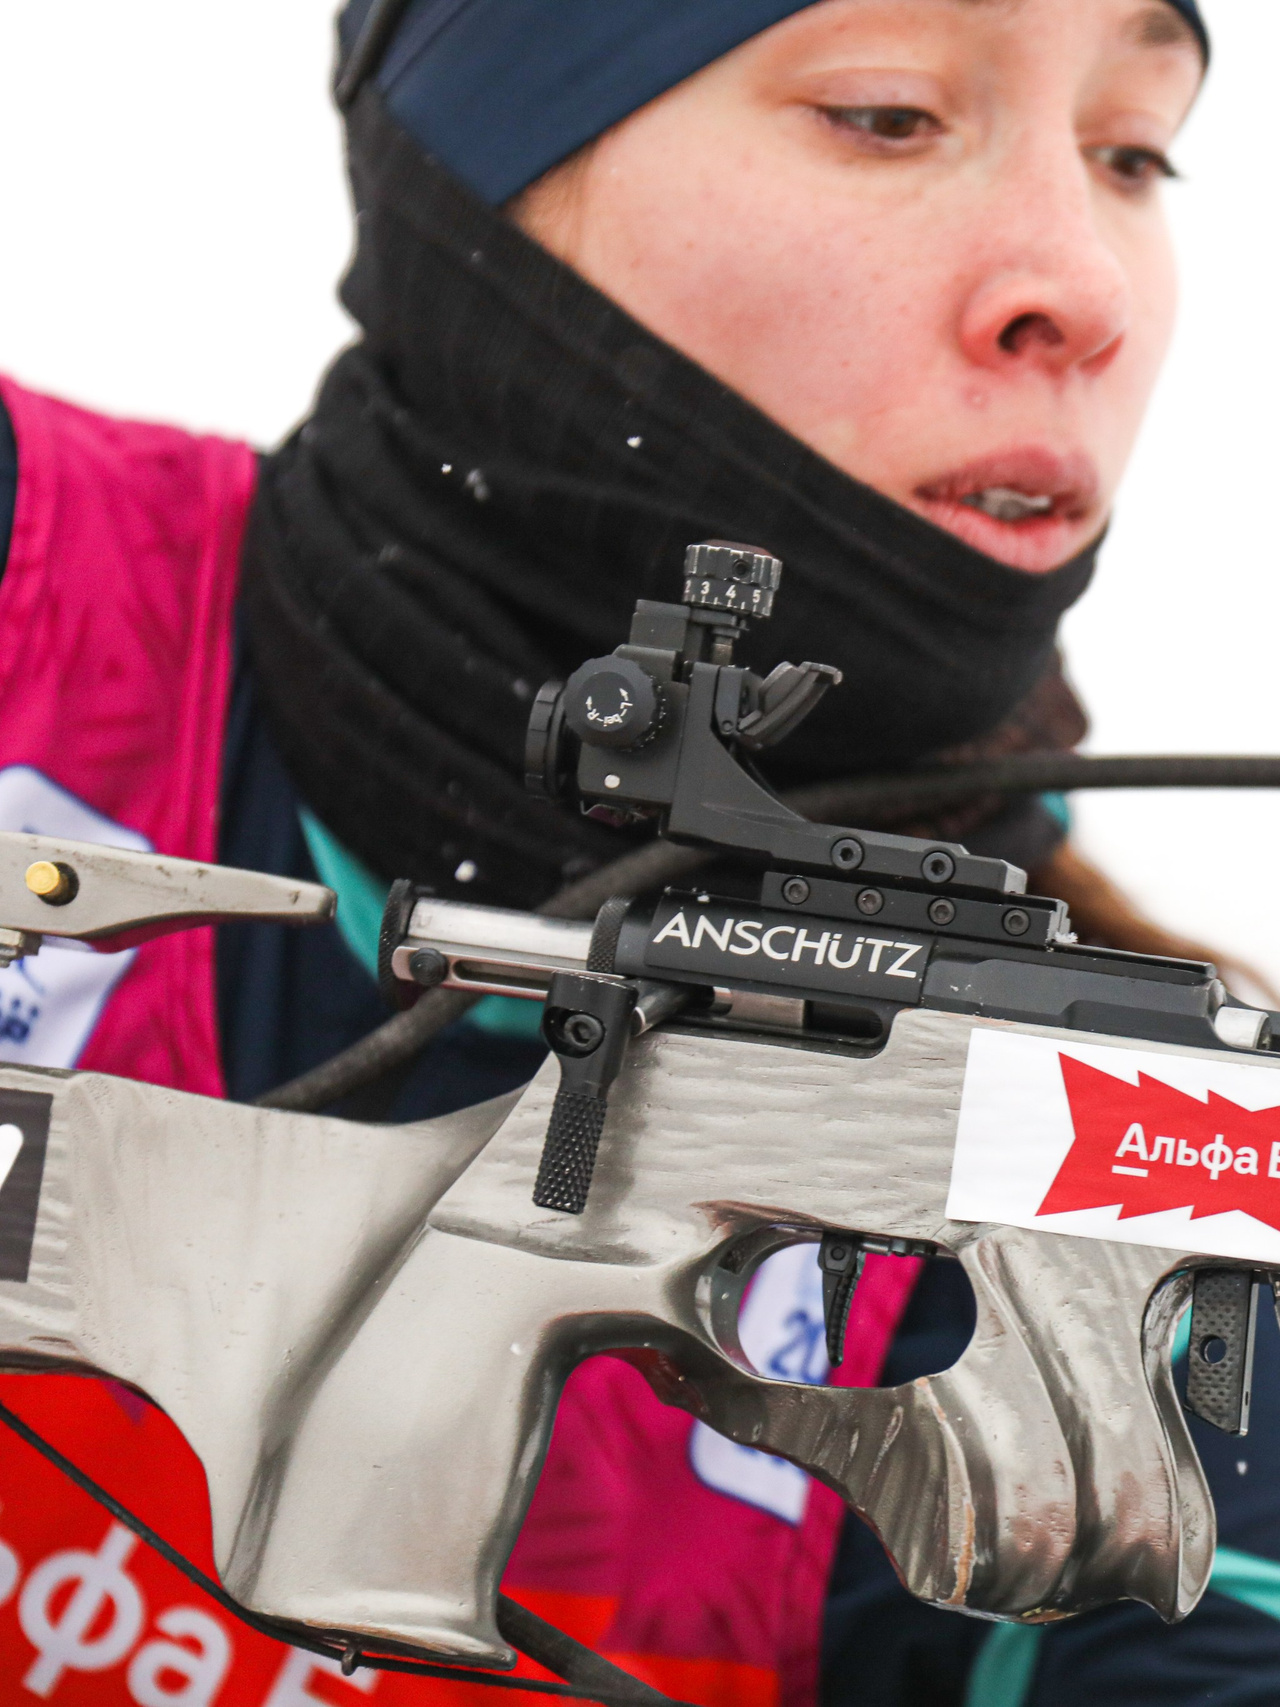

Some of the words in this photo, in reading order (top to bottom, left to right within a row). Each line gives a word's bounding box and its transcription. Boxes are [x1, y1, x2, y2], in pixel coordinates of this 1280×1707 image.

[700, 581, 710, 595] 3
[725, 584, 737, 599] 4
[752, 589, 762, 604] 5
[652, 911, 924, 979] ANSCHÜTZ
[1111, 1122, 1259, 1181] Альфа
